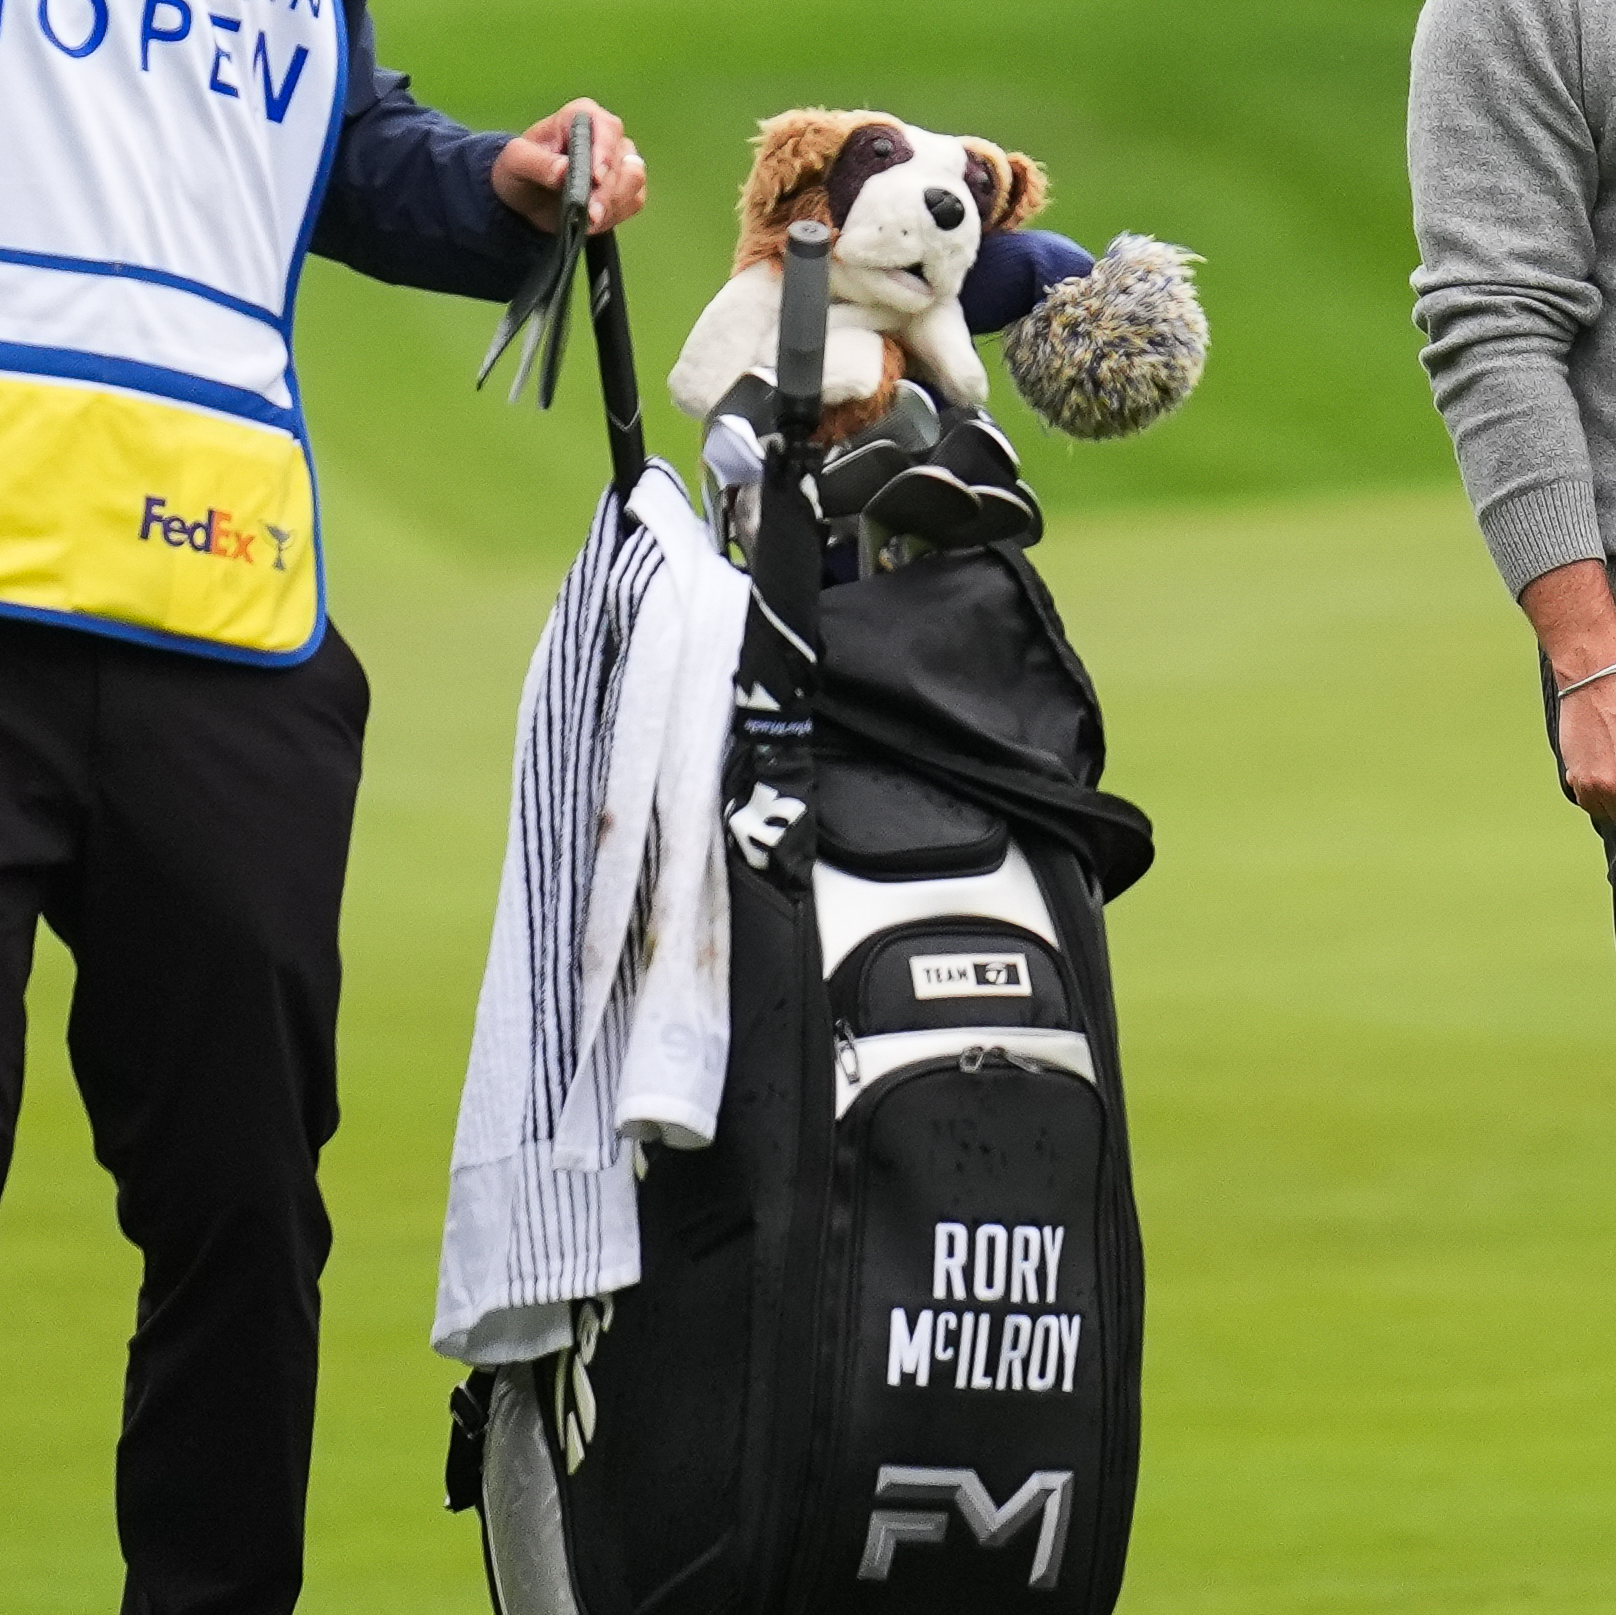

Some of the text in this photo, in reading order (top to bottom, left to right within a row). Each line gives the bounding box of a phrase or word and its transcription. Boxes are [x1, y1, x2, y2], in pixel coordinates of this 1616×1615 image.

[138, 496, 254, 564] FedEx
[923, 967, 968, 983] TEAM
[932, 1222, 1065, 1303] RORY
